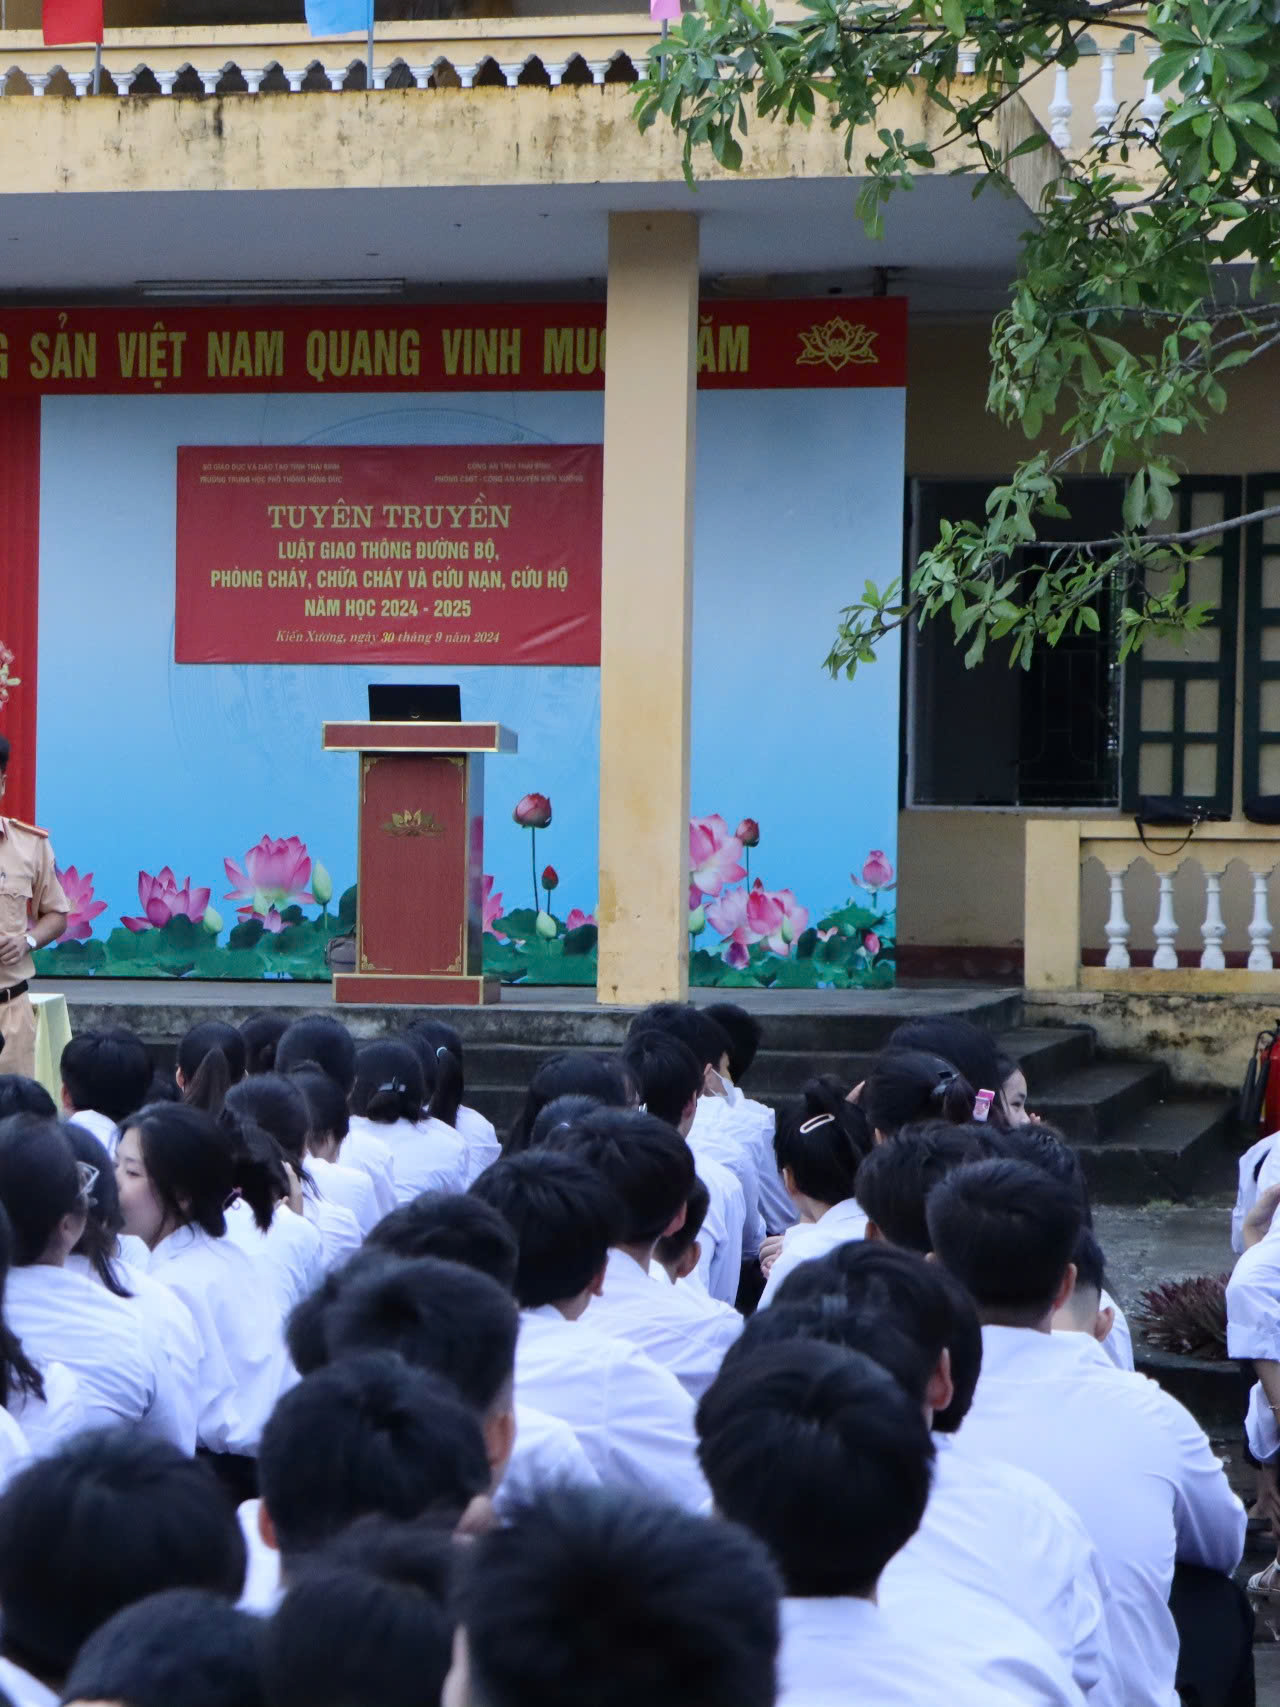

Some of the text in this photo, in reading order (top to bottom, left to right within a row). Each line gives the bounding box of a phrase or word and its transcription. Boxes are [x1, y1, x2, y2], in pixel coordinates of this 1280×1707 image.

[30, 312, 96, 378] SẢN
[118, 321, 187, 389] VIỆT
[207, 331, 284, 378] NAM
[306, 329, 421, 382] QUANG
[441, 327, 521, 376] VINH
[543, 327, 607, 375] MU
[696, 314, 750, 373] ĂM
[268, 492, 511, 529] TUYÊN TRUYỀN
[278, 537, 499, 563] LUẬT GIAO THÔNG ĐƯỜNG BỘ,
[211, 565, 568, 592] PHÒNG CHÁY, CHỮA CHÁY VÀ CỨU NẠN, CỨU HỘ
[304, 595, 340, 616] NĂM
[345, 600, 376, 621] HỌC
[381, 599, 418, 617] 2024
[434, 599, 471, 617] 2025
[381, 632, 395, 642] 30
[398, 631, 432, 645] tháng
[435, 632, 441, 642] 9
[445, 632, 470, 642] năm
[474, 632, 500, 643] 2024
